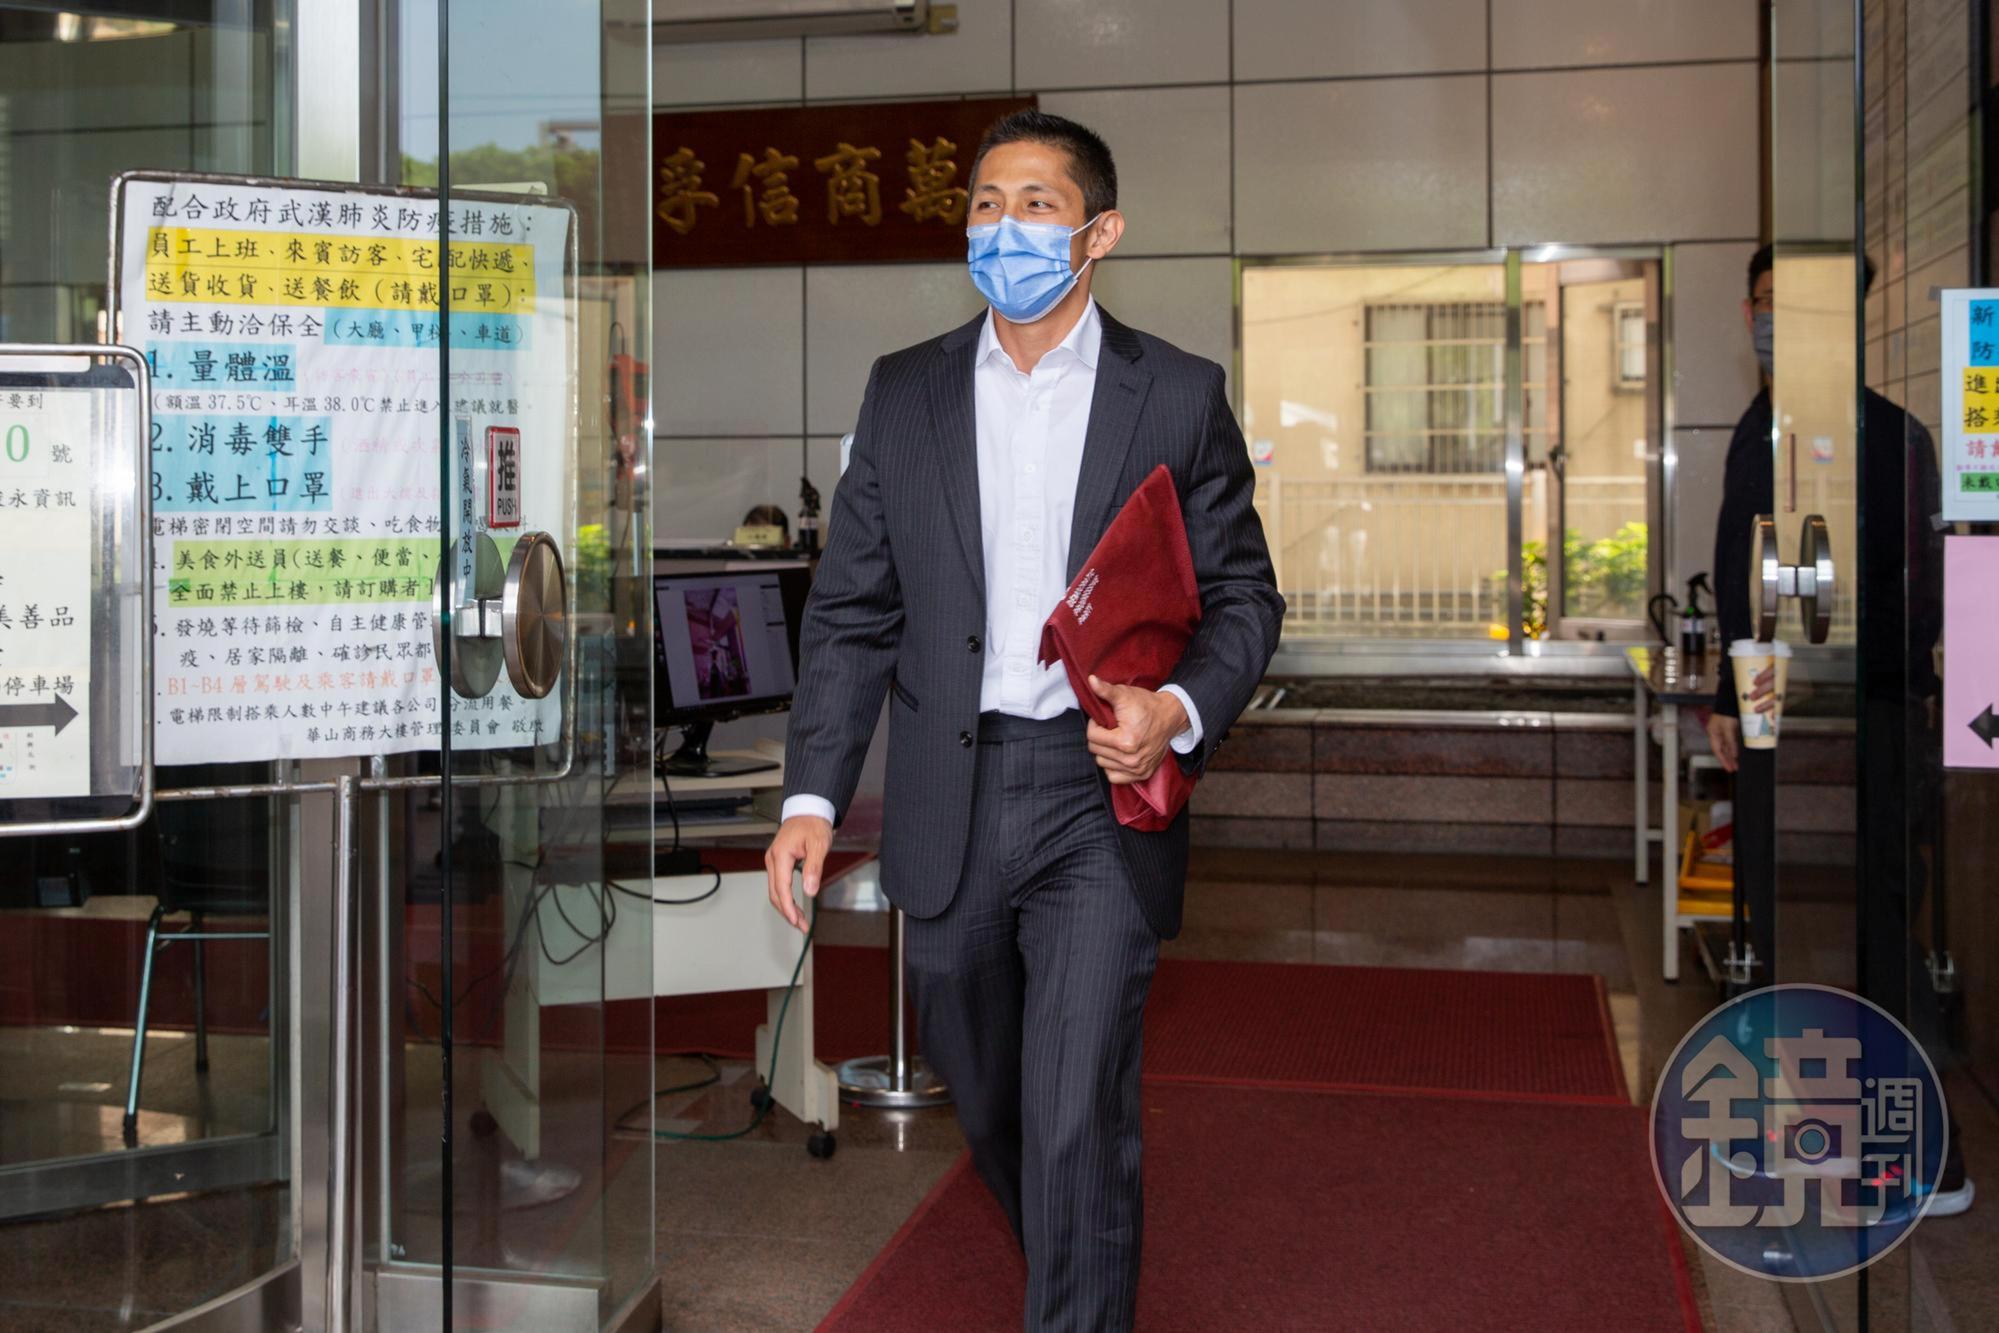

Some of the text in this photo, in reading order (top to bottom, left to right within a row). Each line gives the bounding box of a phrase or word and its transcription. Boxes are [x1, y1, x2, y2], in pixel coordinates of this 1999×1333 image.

[0, 393, 44, 410] 要到
[497, 440, 517, 492] 推
[1962, 474, 1999, 490] 未戴
[0, 488, 77, 508] 永資訊
[497, 497, 517, 516] PUSH
[176, 547, 440, 571] 美食外送員(送餐、便當、
[175, 611, 433, 637] 發燒等待篩檢、自主健康管
[4, 674, 75, 697] 停車場
